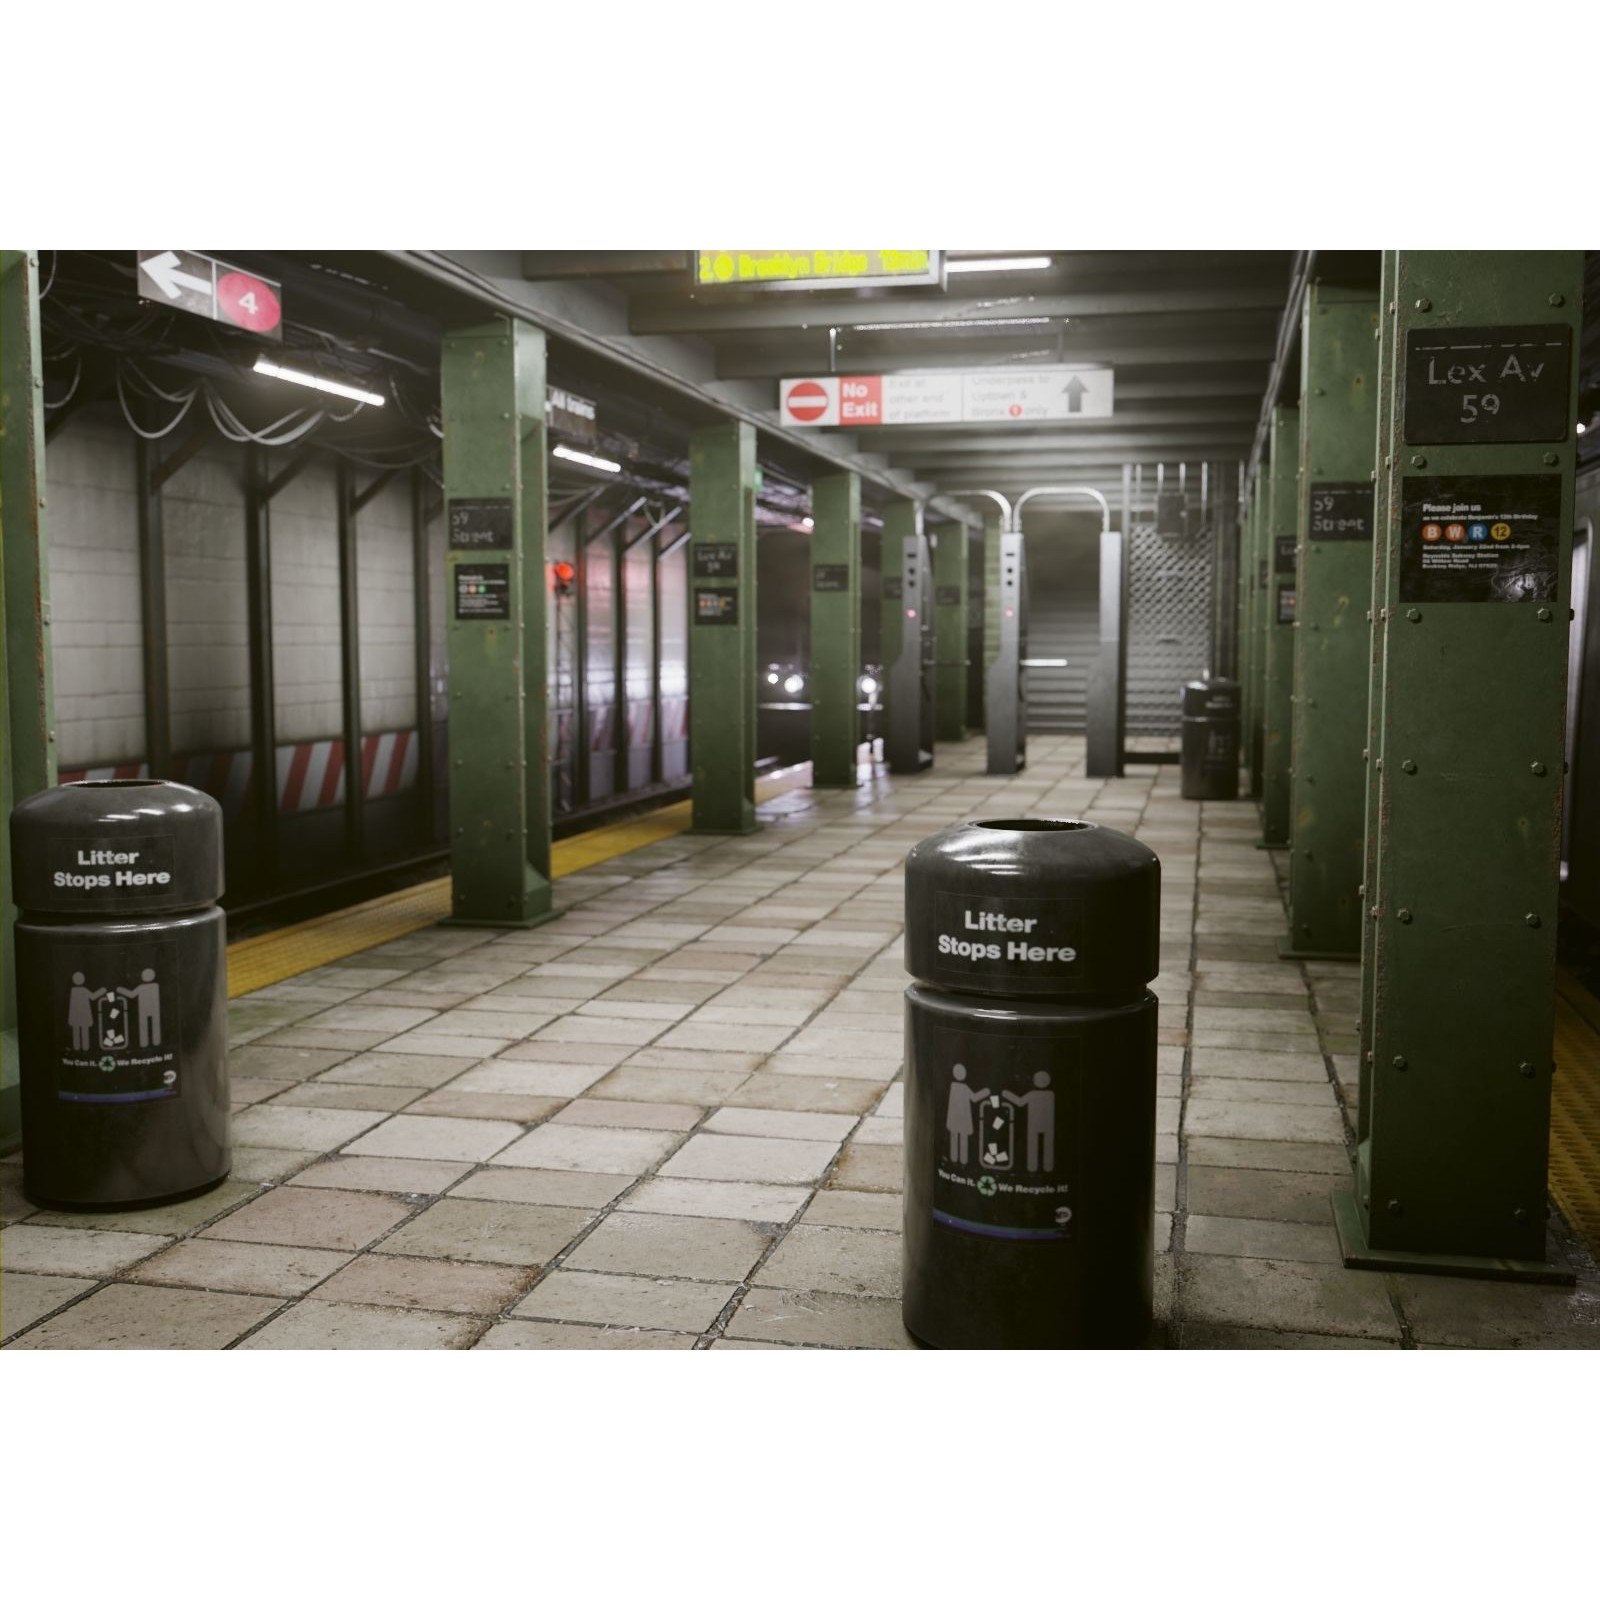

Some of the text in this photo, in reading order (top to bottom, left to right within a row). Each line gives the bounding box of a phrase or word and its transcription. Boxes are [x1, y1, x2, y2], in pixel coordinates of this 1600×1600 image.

[238, 291, 259, 315] 4
[1428, 353, 1545, 385] Lex Av
[841, 383, 868, 398] No
[841, 402, 878, 418] Exit
[1460, 393, 1501, 423] 59
[1422, 503, 1482, 513] Please join us
[1494, 526, 1507, 537] 12
[77, 850, 139, 866] Litter
[53, 870, 171, 890] Stops Here
[964, 909, 1038, 934] Litter
[938, 933, 1077, 962] Stops Here
[937, 1168, 950, 1181] You
[951, 1173, 967, 1186] Can
[998, 1183, 1014, 1193] We
[1015, 1184, 1056, 1195] Recycle
